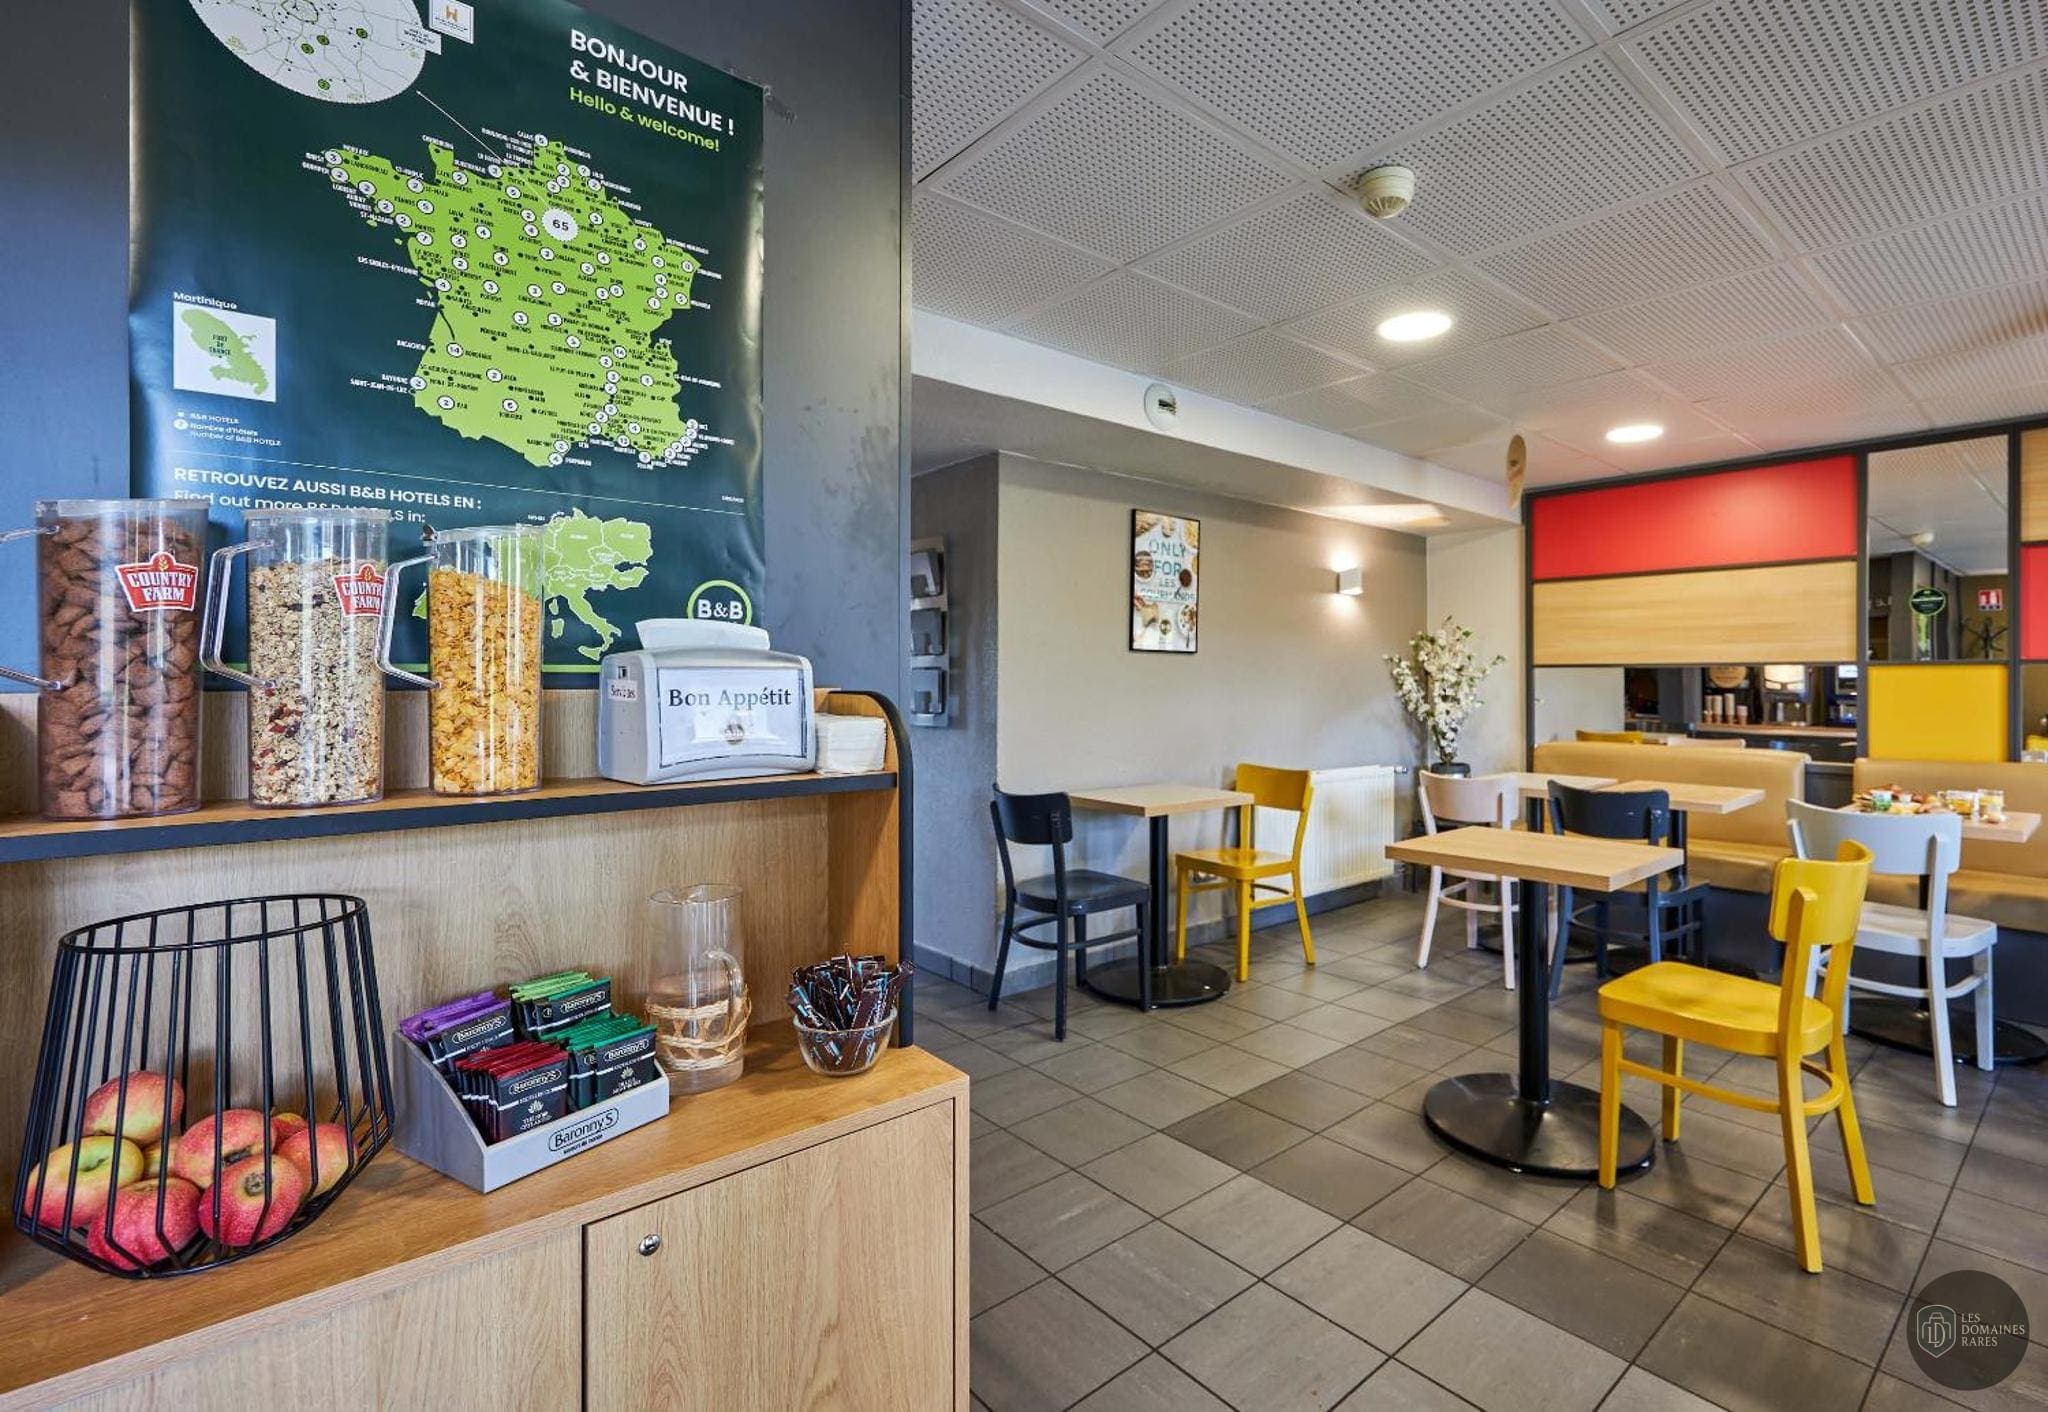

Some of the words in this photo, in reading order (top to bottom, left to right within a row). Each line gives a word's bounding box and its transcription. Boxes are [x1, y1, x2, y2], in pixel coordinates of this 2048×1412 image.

[571, 29, 688, 93] BONJOUR
[570, 60, 590, 83] &
[597, 69, 722, 131] BIENVENUE
[728, 118, 734, 135] !
[570, 87, 616, 114] Hello
[619, 106, 634, 122] &
[638, 114, 720, 152] welcome!
[553, 219, 569, 231] 65
[173, 292, 238, 310] Martinique
[174, 467, 289, 490] RETROUVEZ
[293, 481, 346, 496] AUSSI
[350, 485, 386, 500] B&B
[390, 490, 450, 506] HOTELS
[454, 496, 474, 509] EN
[219, 496, 251, 508] out
[1149, 539, 1186, 558] ONLY
[1154, 560, 1182, 576] FOR
[127, 571, 193, 588] COUNTRY
[142, 587, 185, 602] FARM
[698, 599, 744, 619] B&B
[668, 688, 710, 707] Bon
[718, 687, 792, 710] Appétit
